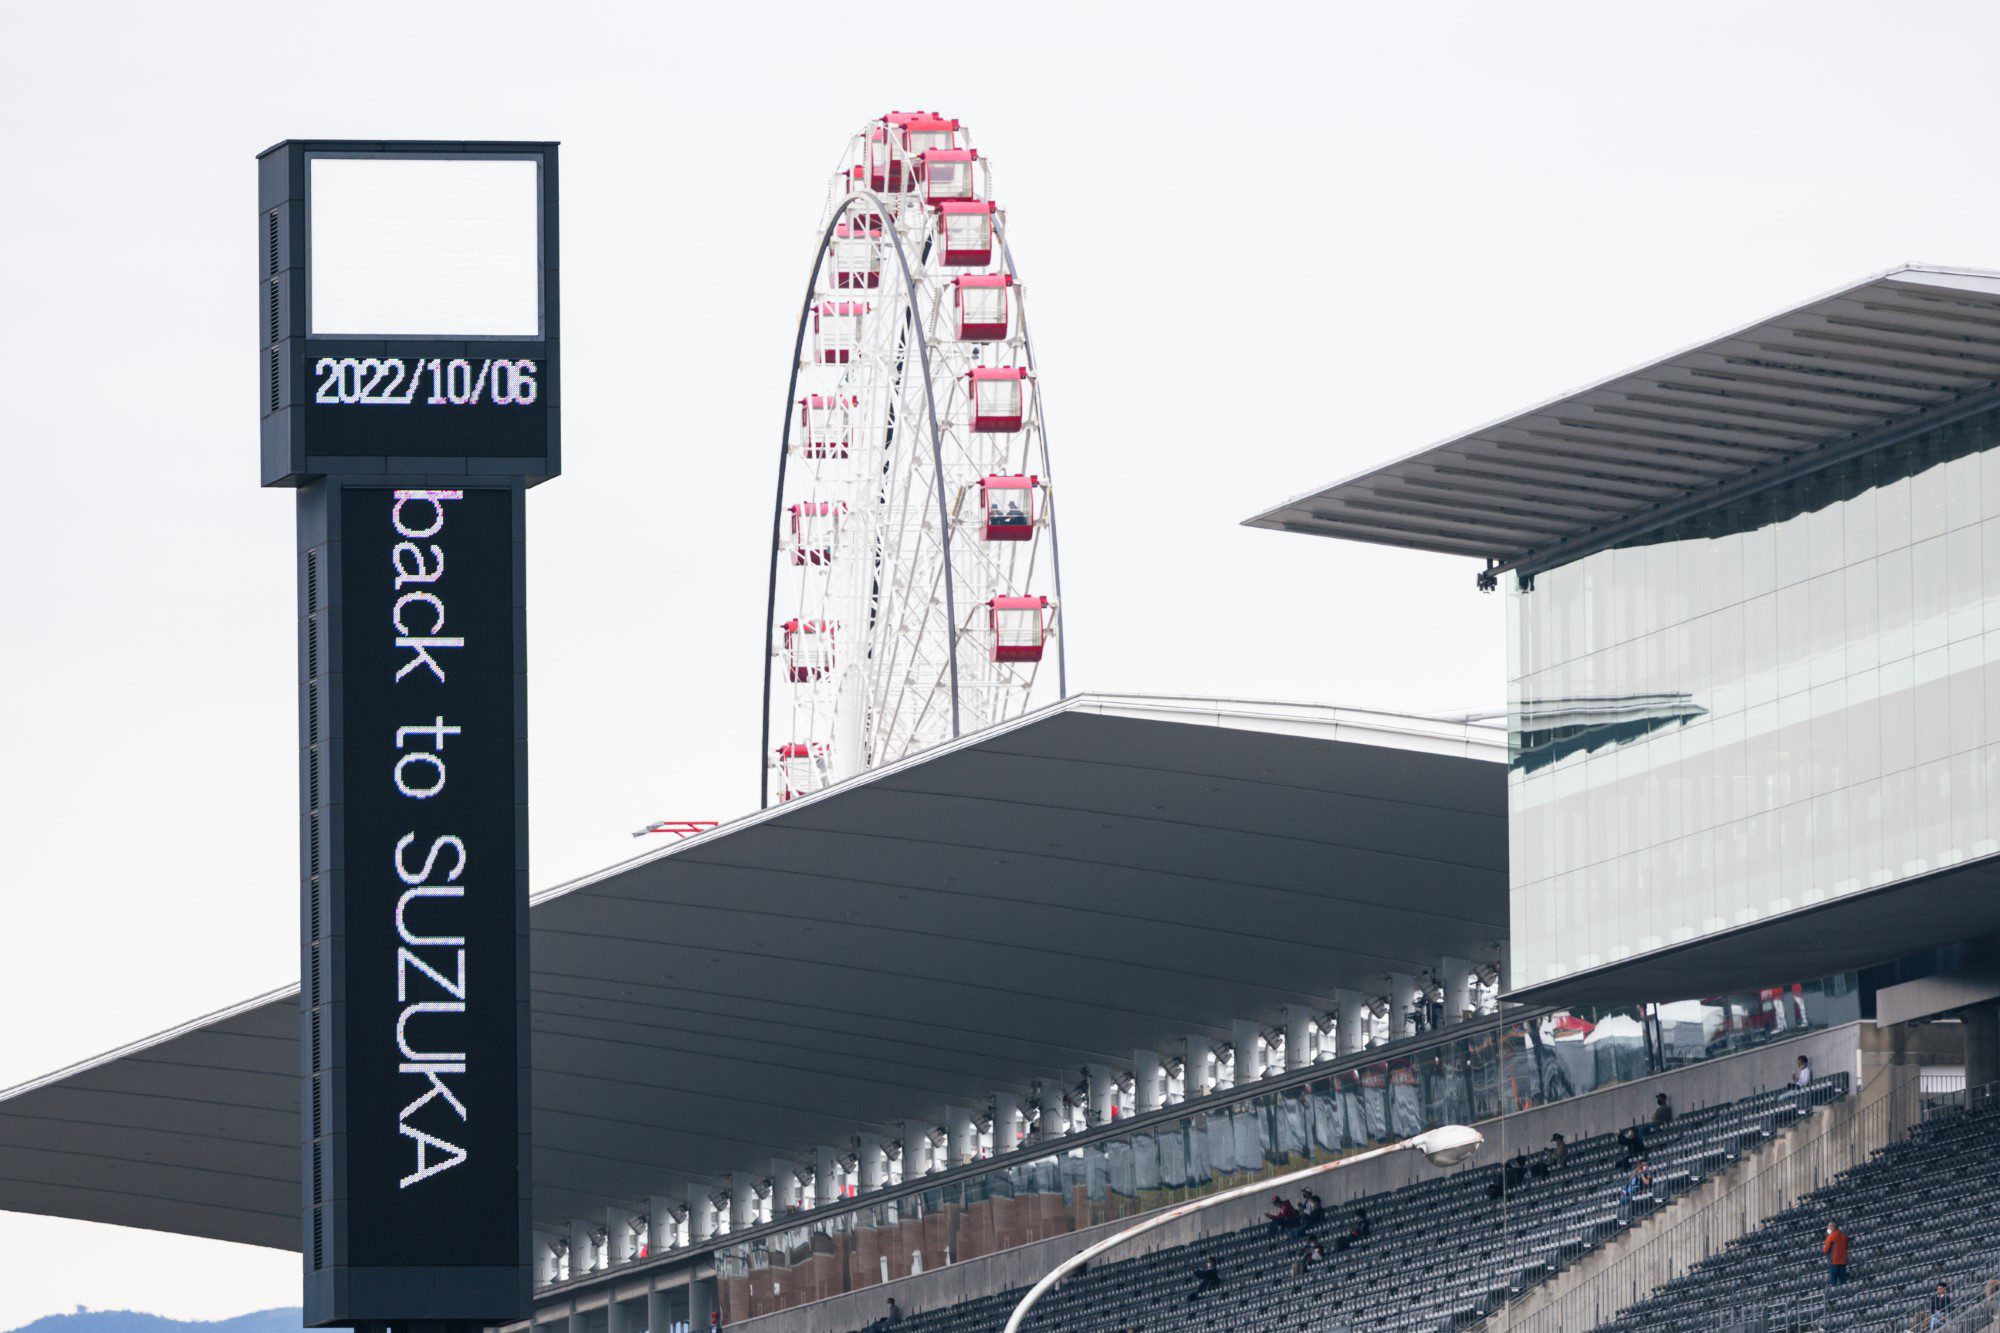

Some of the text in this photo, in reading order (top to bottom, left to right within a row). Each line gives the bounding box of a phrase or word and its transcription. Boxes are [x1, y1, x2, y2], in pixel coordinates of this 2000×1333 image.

[315, 358, 537, 405] 2022/10/06
[392, 490, 467, 1188] back to SUZUKA
